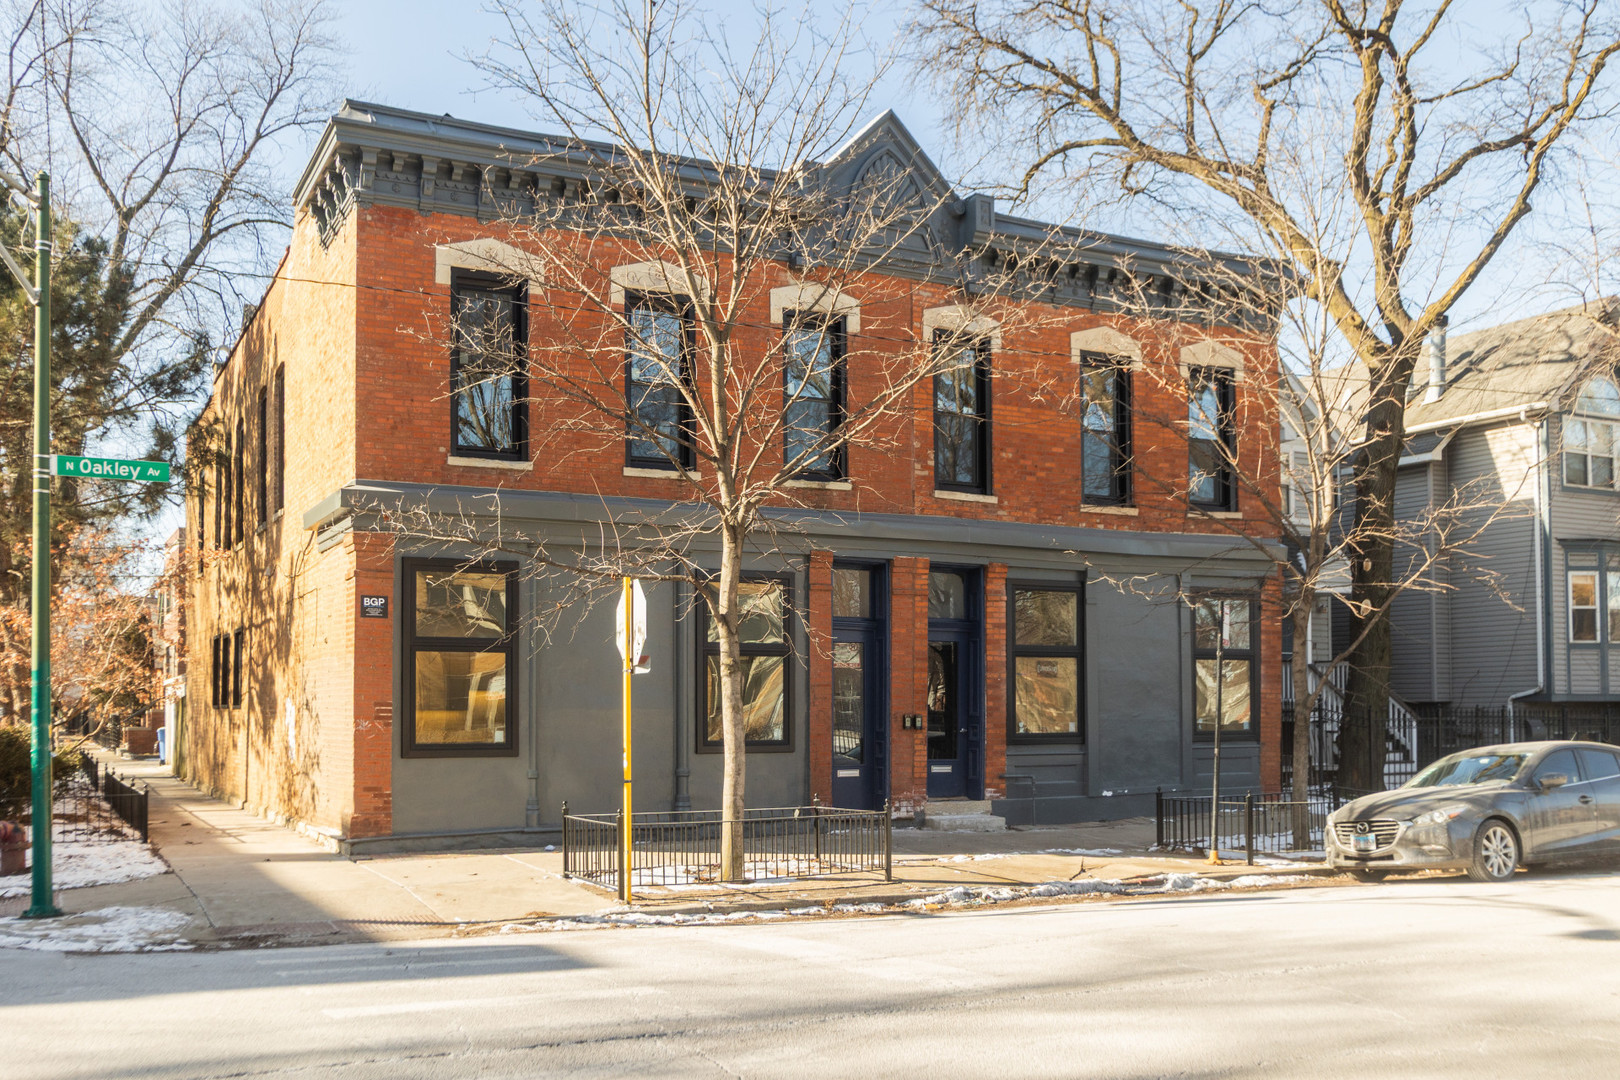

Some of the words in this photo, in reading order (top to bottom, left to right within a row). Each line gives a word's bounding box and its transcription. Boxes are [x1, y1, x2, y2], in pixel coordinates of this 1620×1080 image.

[66, 461, 74, 470] N
[79, 459, 141, 480] Oakley
[147, 467, 160, 476] Av
[363, 597, 385, 606] BGP
